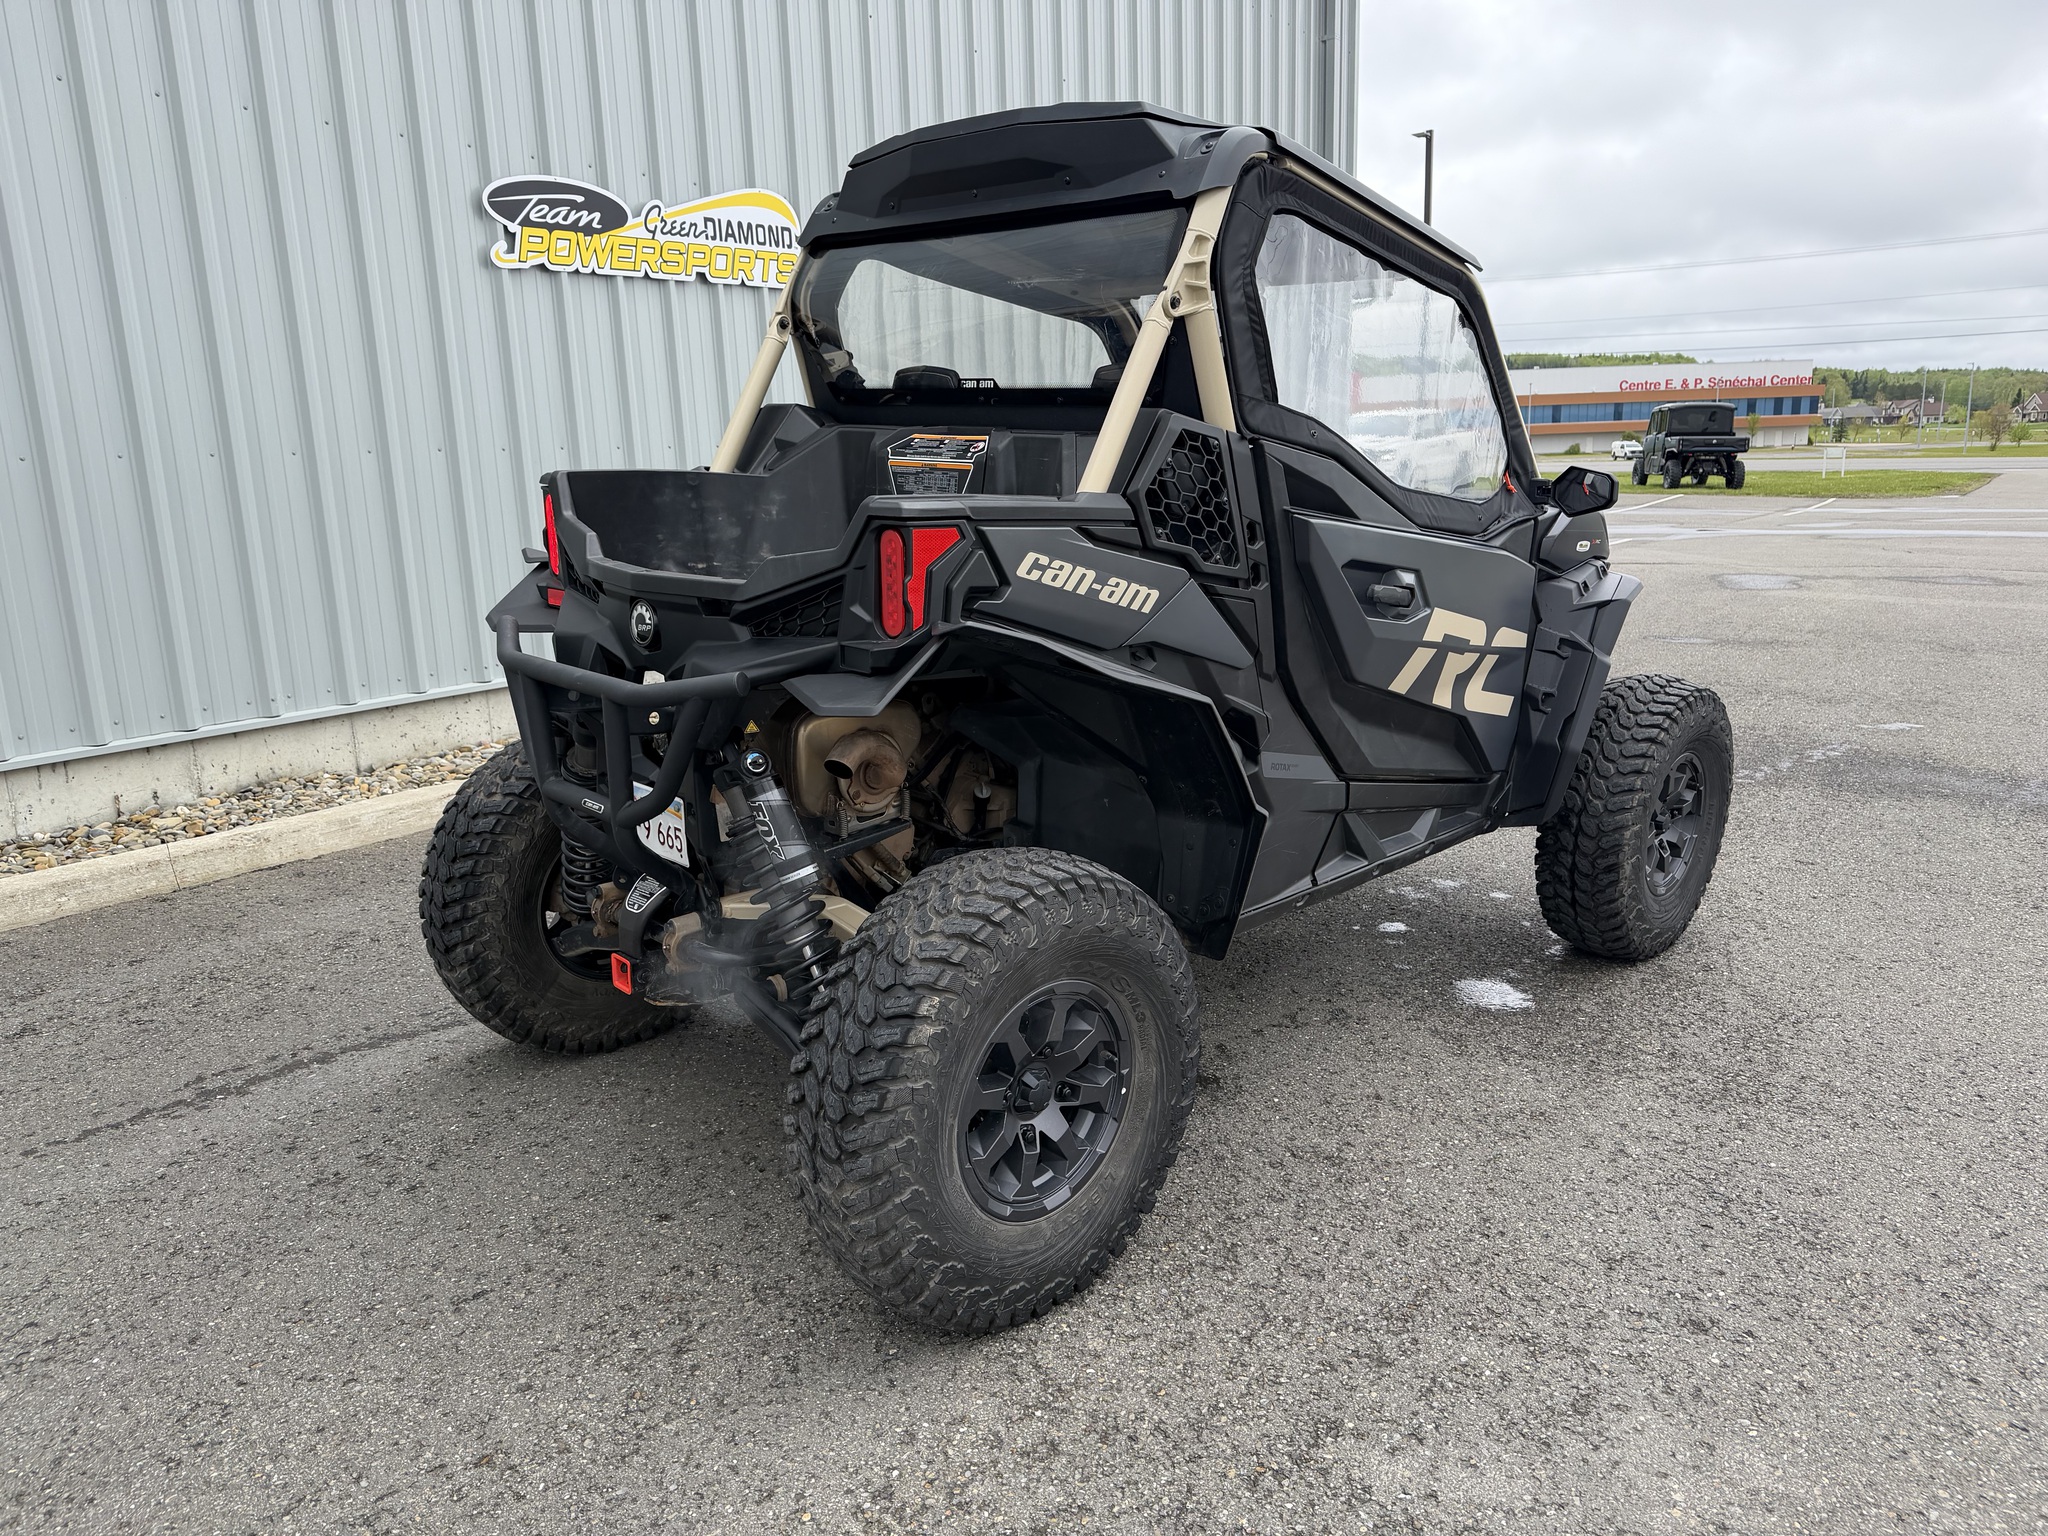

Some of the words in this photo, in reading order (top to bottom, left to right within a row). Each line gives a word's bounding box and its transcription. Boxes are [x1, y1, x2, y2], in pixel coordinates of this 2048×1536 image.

[488, 193, 602, 229] Team
[643, 203, 707, 240] Green
[703, 216, 793, 250] DIAMOND
[518, 226, 799, 284] POWERSPORTS
[1619, 379, 1662, 392] Centre
[1665, 378, 1677, 390] E.
[1680, 377, 1690, 390] &
[1694, 377, 1705, 389] P.
[1708, 375, 1767, 390] Sénéchal
[1770, 373, 1813, 387] Center
[1015, 551, 1160, 614] can-am
[637, 624, 652, 632] BRP
[1270, 762, 1291, 772] ROTAX
[657, 821, 683, 854] 665
[747, 801, 786, 861] FOX
